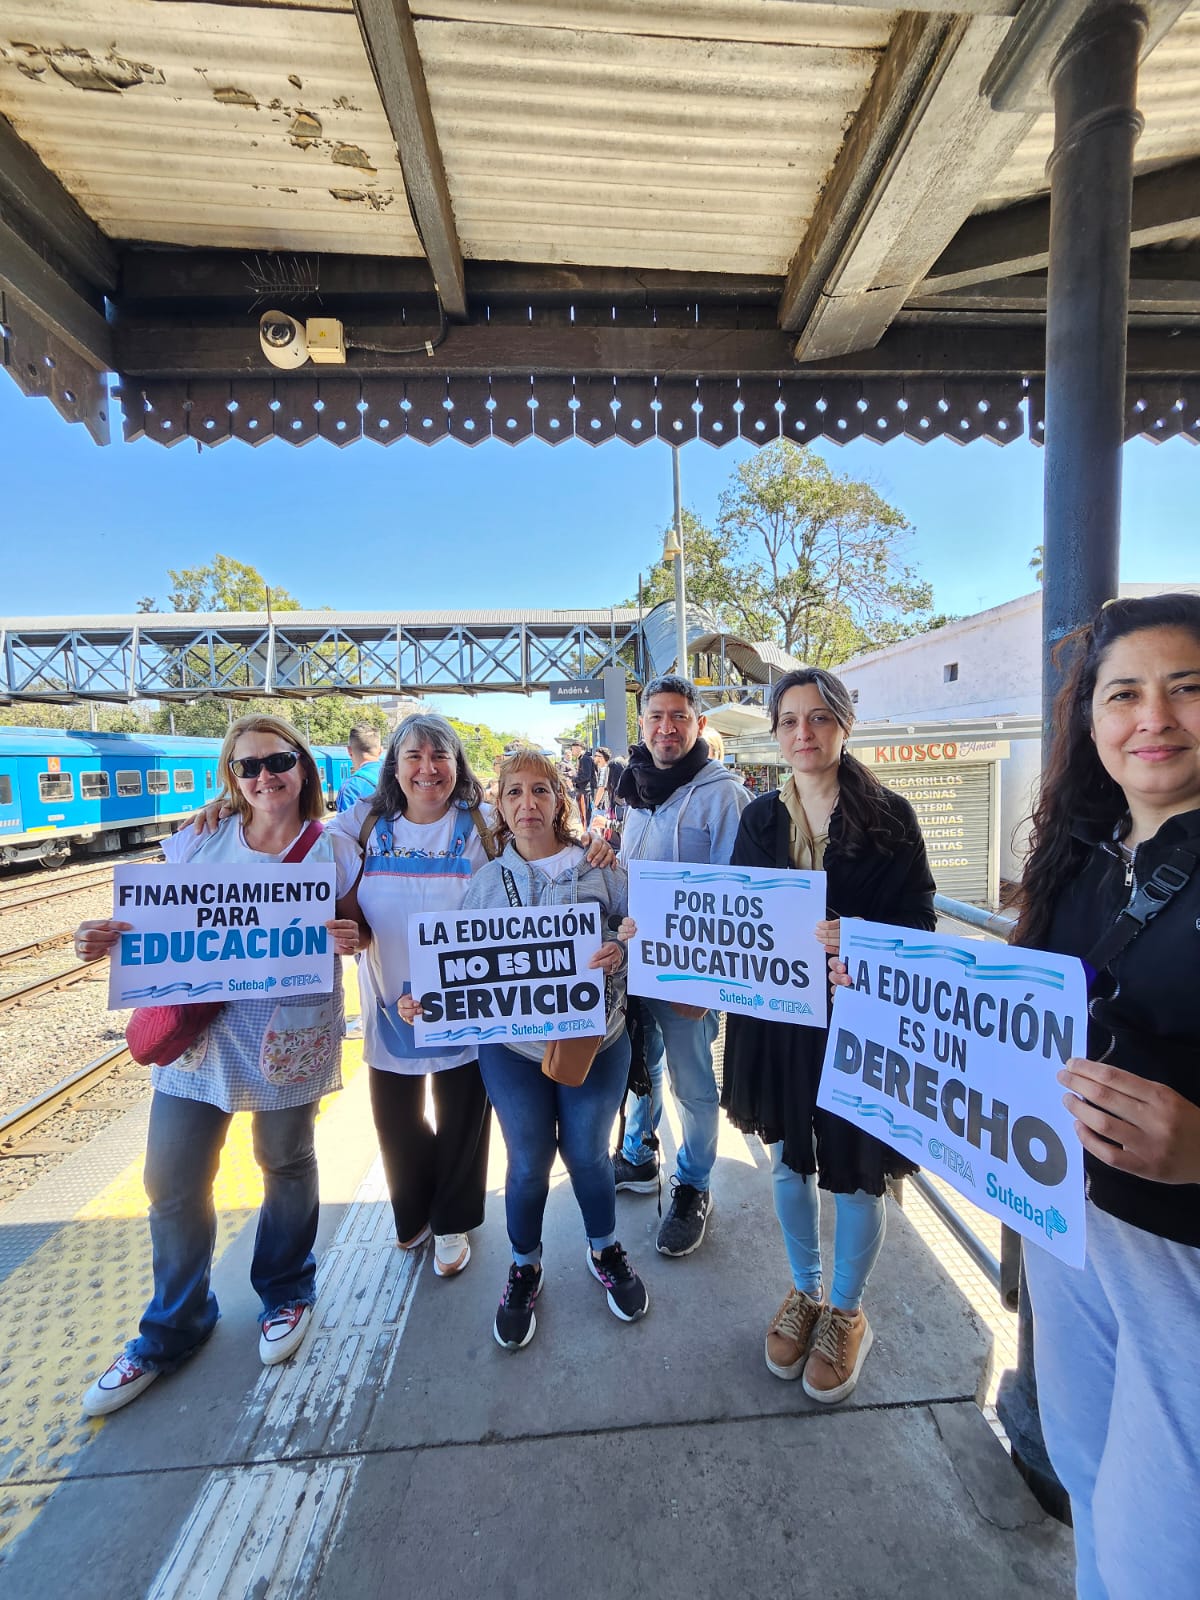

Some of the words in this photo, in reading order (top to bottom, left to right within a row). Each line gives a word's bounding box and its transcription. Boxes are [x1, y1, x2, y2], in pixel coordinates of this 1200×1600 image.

[557, 686, 583, 695] Andén
[584, 685, 590, 694] 4
[874, 741, 958, 763] KIOSCO
[888, 775, 964, 787] CIGARRILLOS
[902, 789, 957, 800] OLOSINAS
[913, 802, 954, 813] ETERIA
[918, 815, 964, 825] ALUNAS
[922, 828, 965, 838] WICHES
[925, 841, 963, 851] ETITAS
[119, 881, 331, 907] FINANCIAMIENTO
[674, 889, 716, 915] POR
[722, 893, 764, 920] LOS
[197, 906, 260, 928] PARA
[418, 921, 450, 946] LA
[456, 908, 596, 943] EDUCACIÓN
[120, 918, 328, 966] EDUCACIÓN
[665, 913, 775, 952] FONDOS
[444, 955, 490, 982] NO
[497, 951, 531, 976] ES
[536, 947, 572, 972] UN
[641, 939, 810, 989] EDUCATIVOS
[228, 978, 265, 992] Suteba
[281, 974, 322, 988] CTERA
[420, 981, 601, 1023] SERVICIO
[719, 988, 753, 1007] Suteba
[768, 998, 814, 1016] CTERA
[878, 964, 1075, 1066] EDUCACIÓN
[511, 1023, 544, 1036] Suteba
[557, 1018, 596, 1033] CTERA
[898, 1015, 926, 1054] ES
[933, 1030, 967, 1073] UN
[832, 1027, 1068, 1188] DERECHO
[927, 1137, 976, 1188] CTERA
[985, 1172, 1044, 1229] Suteba
